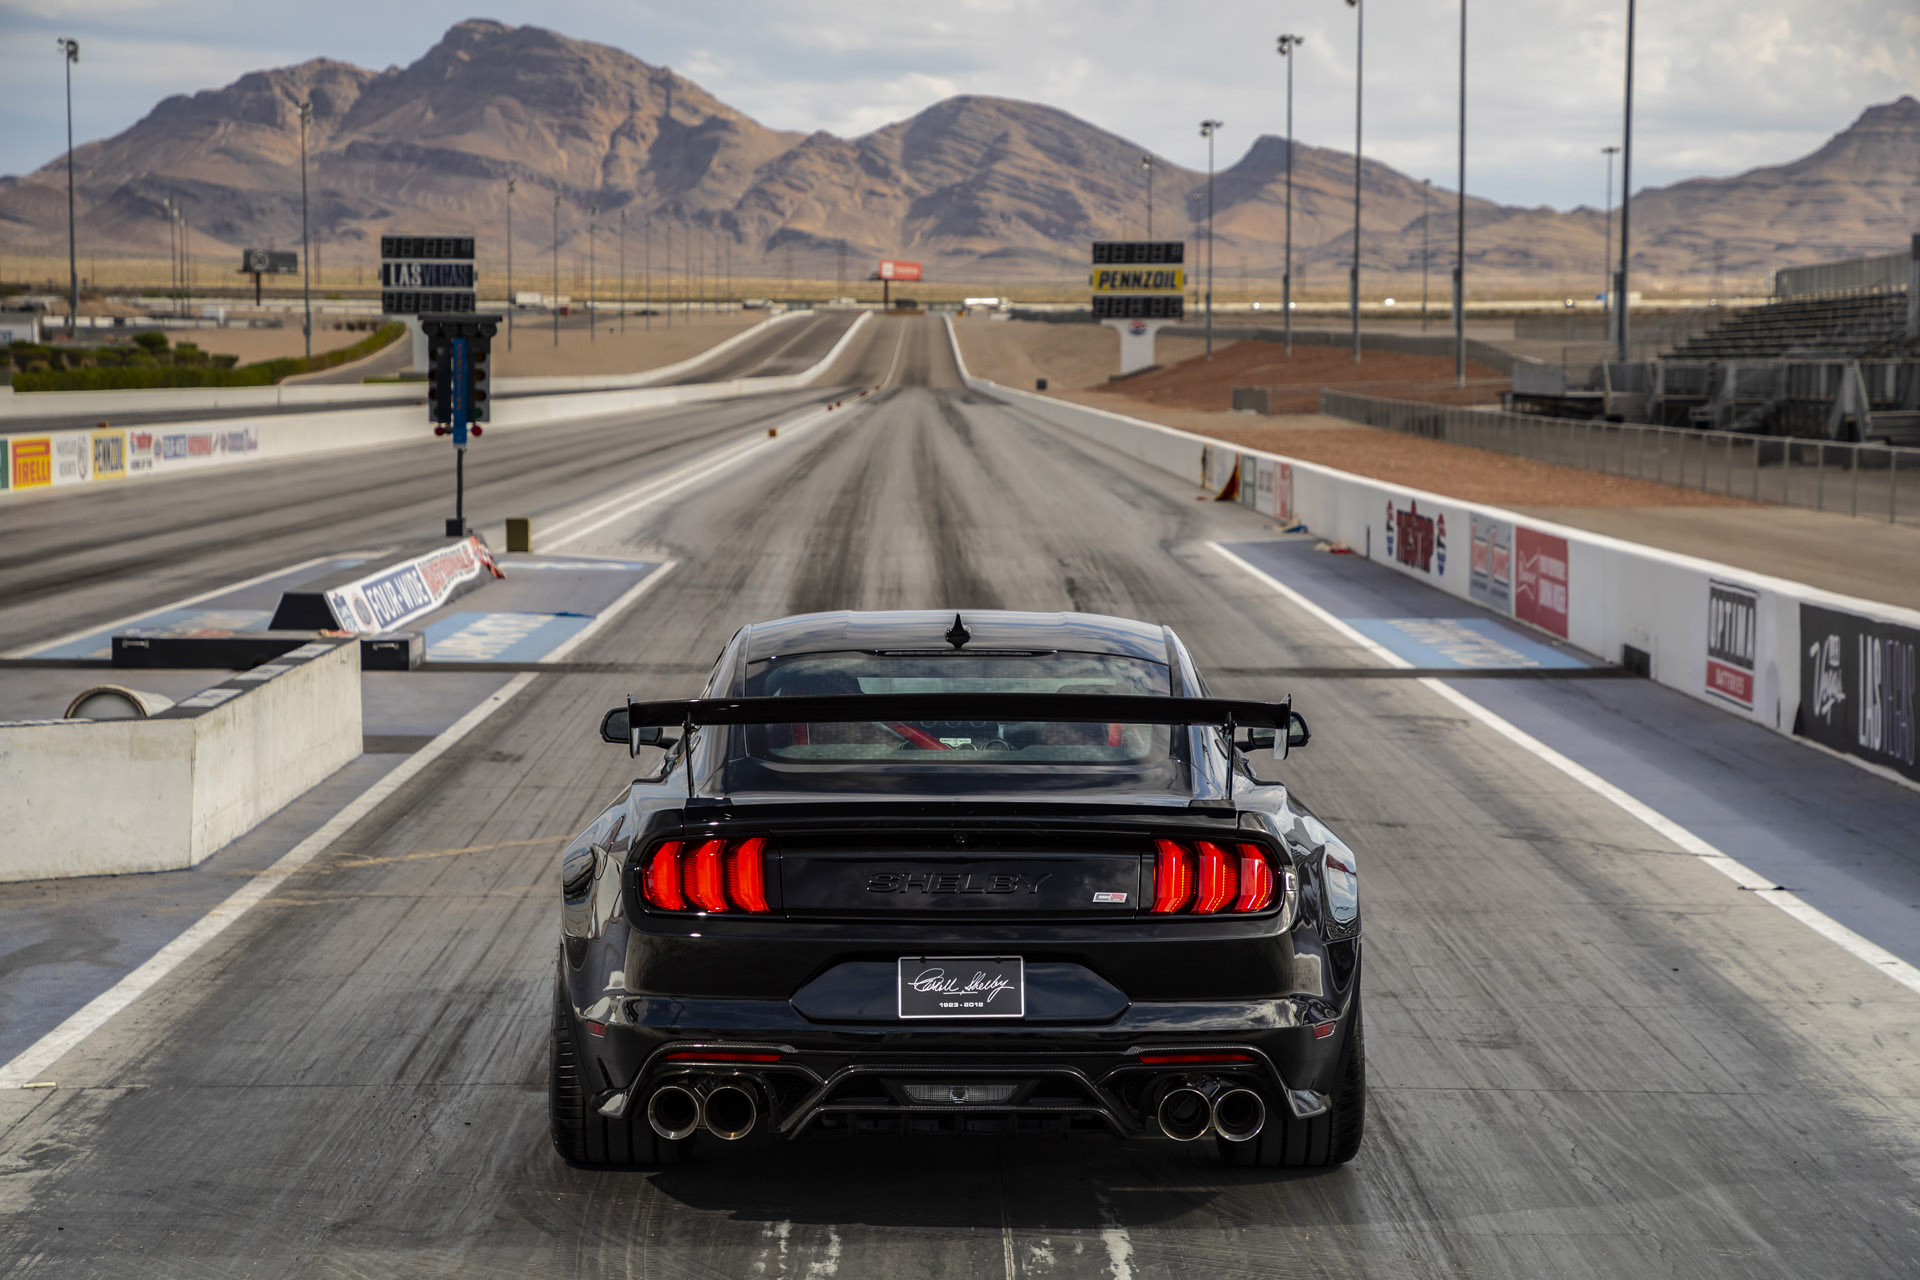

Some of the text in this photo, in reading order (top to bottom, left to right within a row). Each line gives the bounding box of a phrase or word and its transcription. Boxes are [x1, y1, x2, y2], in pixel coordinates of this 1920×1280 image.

[390, 263, 422, 287] LAS
[1098, 270, 1179, 289] PENNZOIL
[12, 441, 51, 487] PIRELLI
[366, 569, 429, 625] FOUR-WIDE
[1710, 597, 1754, 660] OPTIMA
[1859, 633, 1882, 751] LAS
[867, 872, 1052, 894] SHELBY
[1094, 892, 1126, 902] CR
[964, 971, 1015, 1003] Shelby
